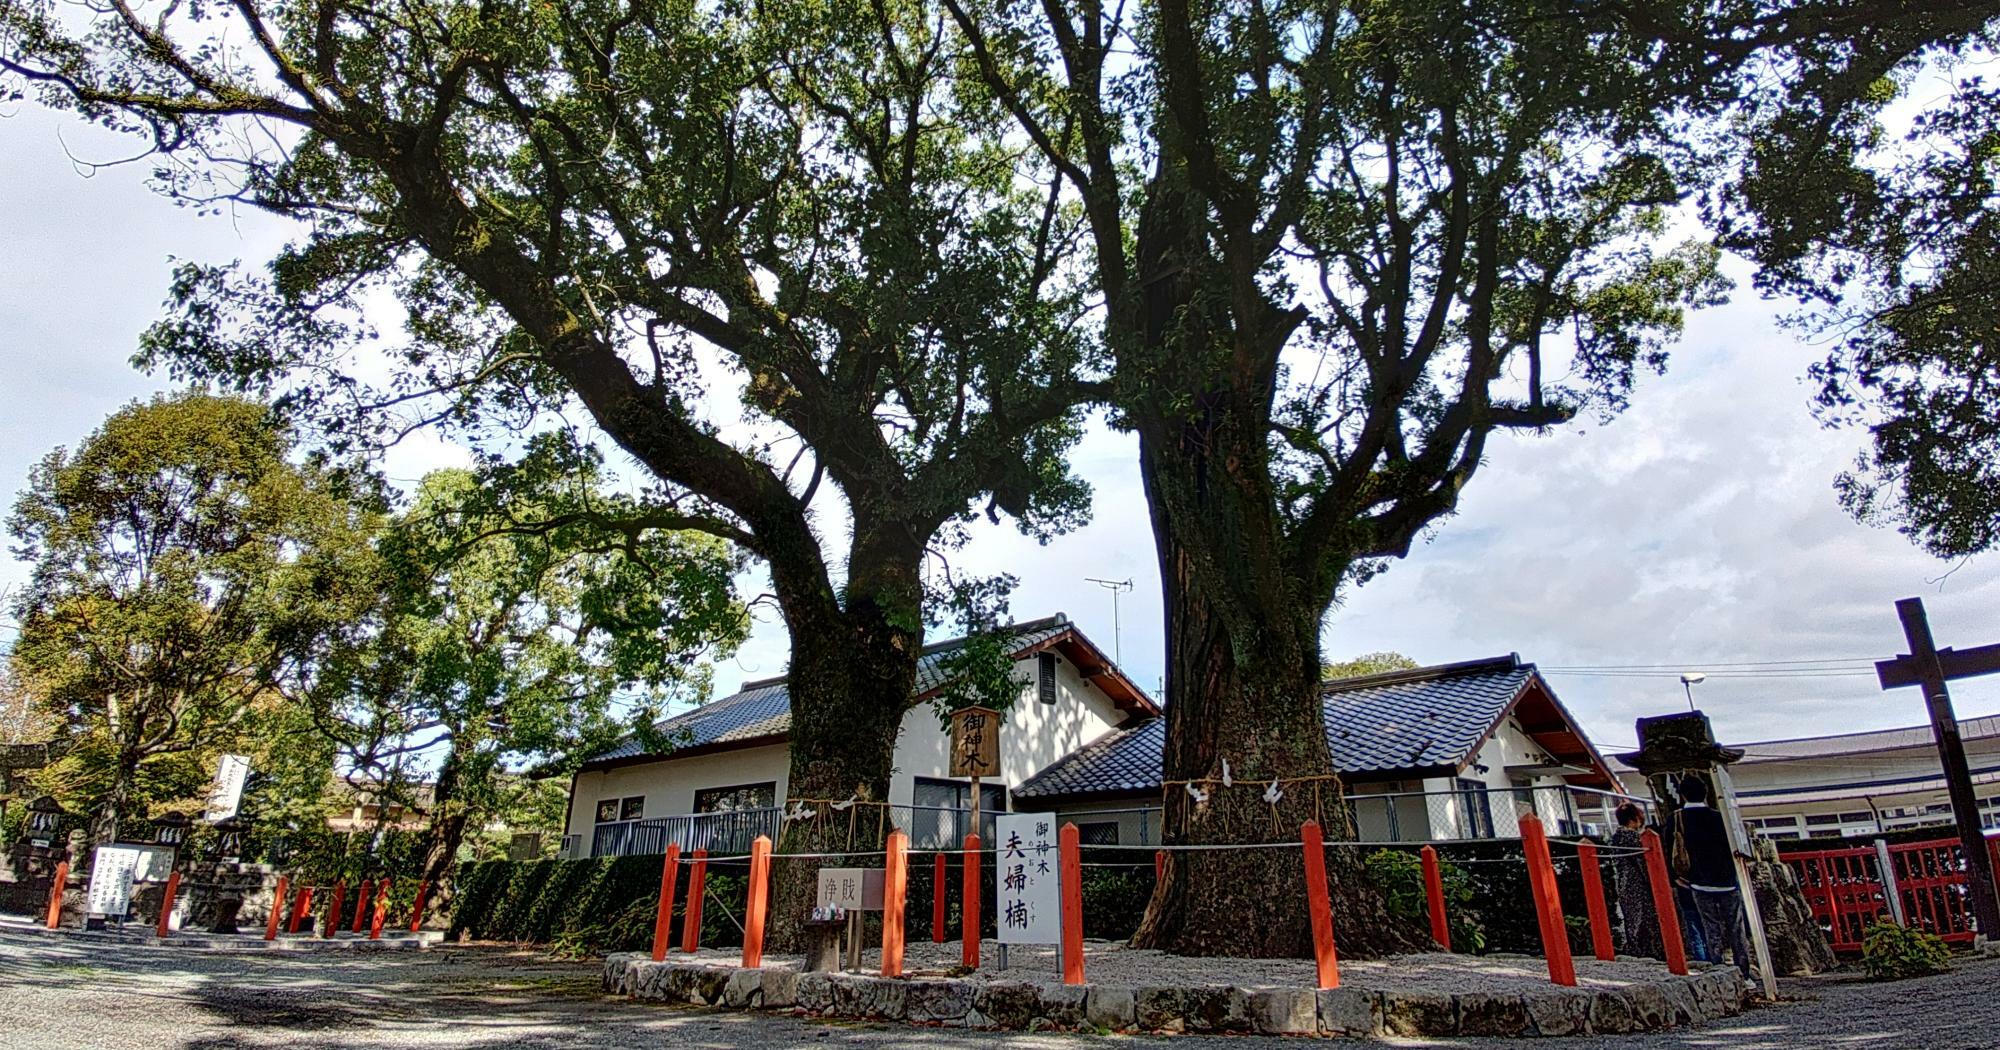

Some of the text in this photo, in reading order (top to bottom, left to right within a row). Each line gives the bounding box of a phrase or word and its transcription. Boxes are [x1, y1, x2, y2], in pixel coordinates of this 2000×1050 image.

[960, 712, 989, 771] 御神木
[1036, 821, 1050, 876] 御神木
[1004, 830, 1027, 929] 夫婦楠
